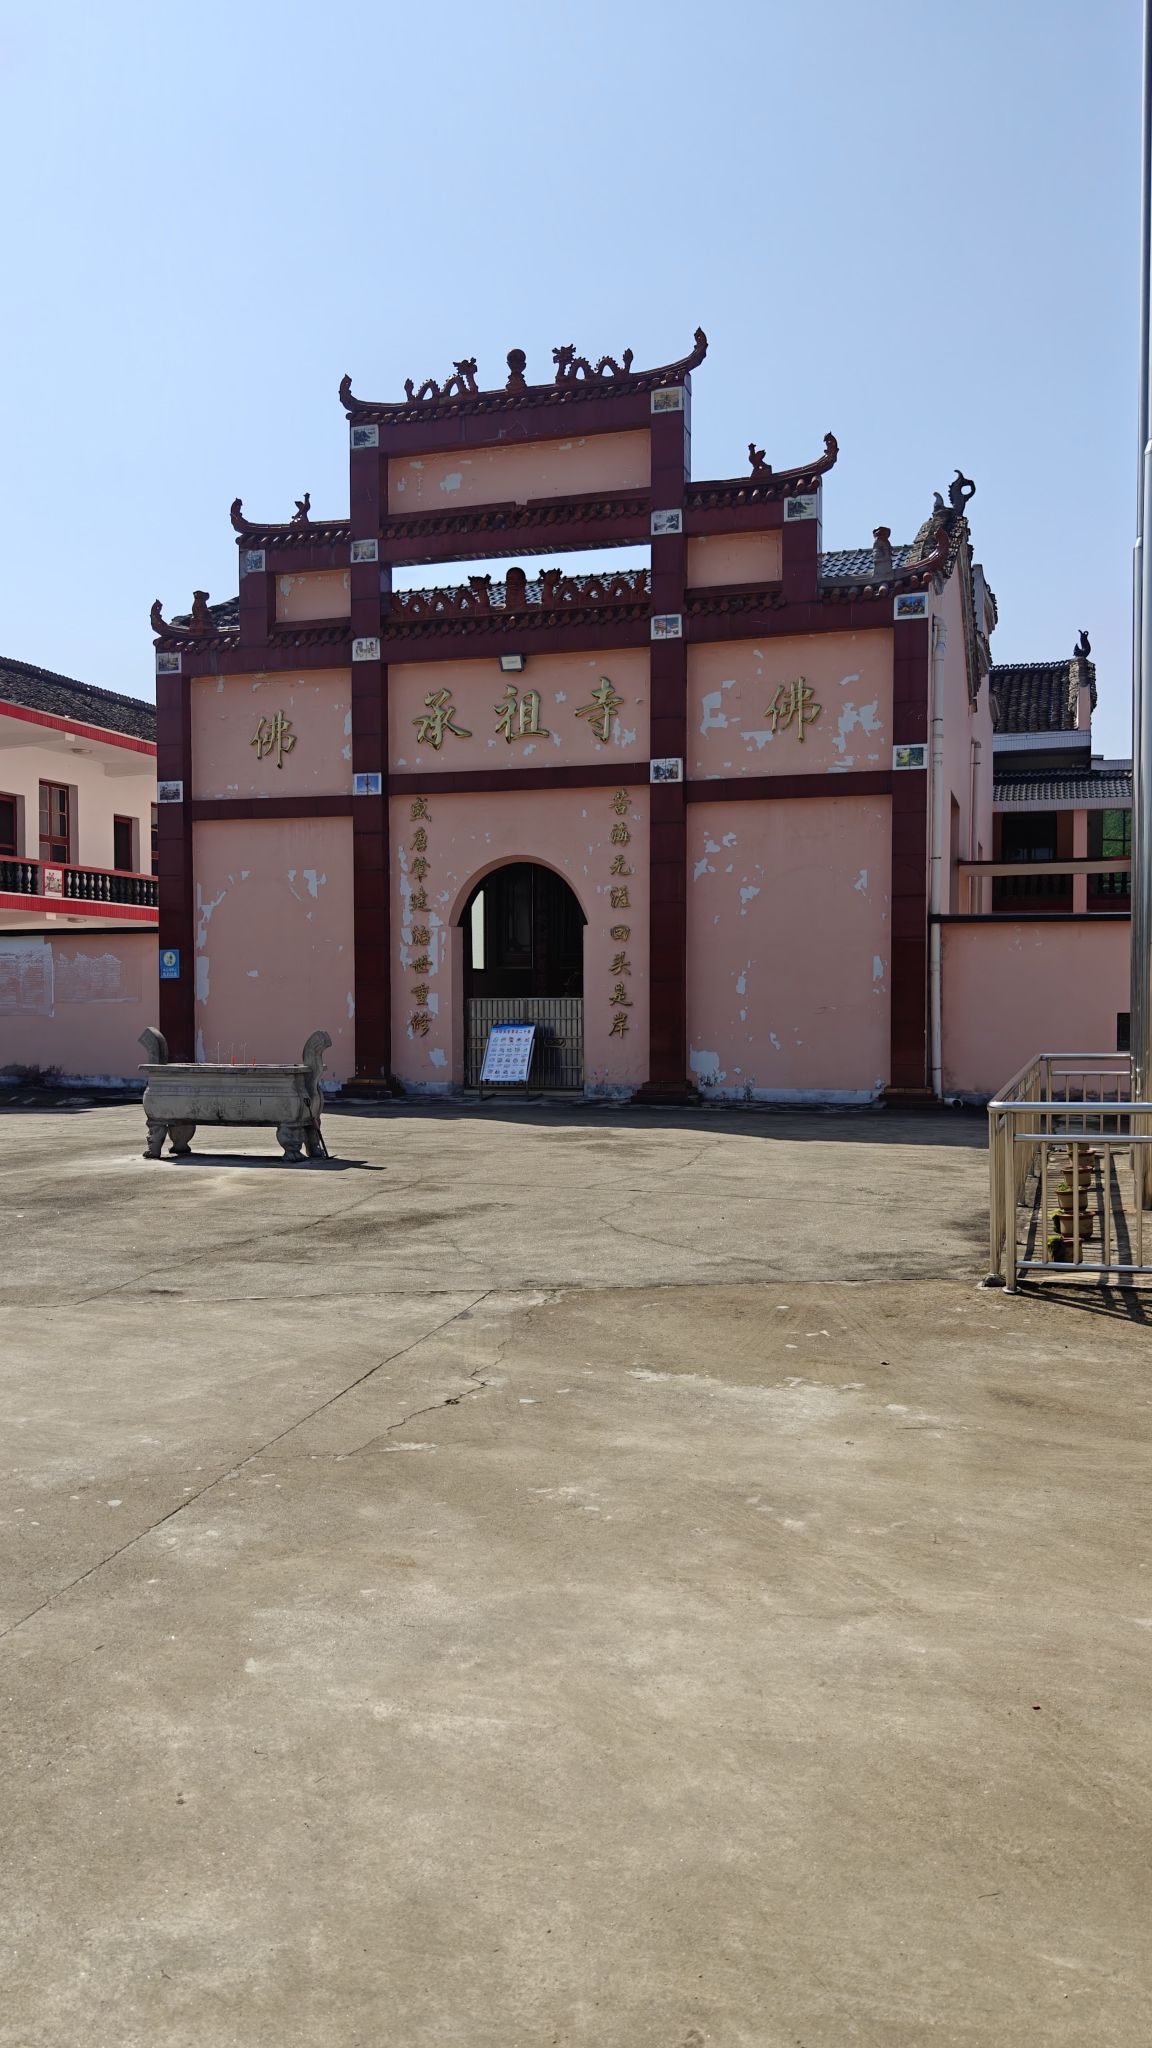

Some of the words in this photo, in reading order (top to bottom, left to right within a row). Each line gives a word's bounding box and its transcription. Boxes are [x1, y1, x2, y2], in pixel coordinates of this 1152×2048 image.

[249, 709, 297, 770] 佛
[412, 676, 625, 751] 承祖寺
[764, 676, 822, 743] 佛
